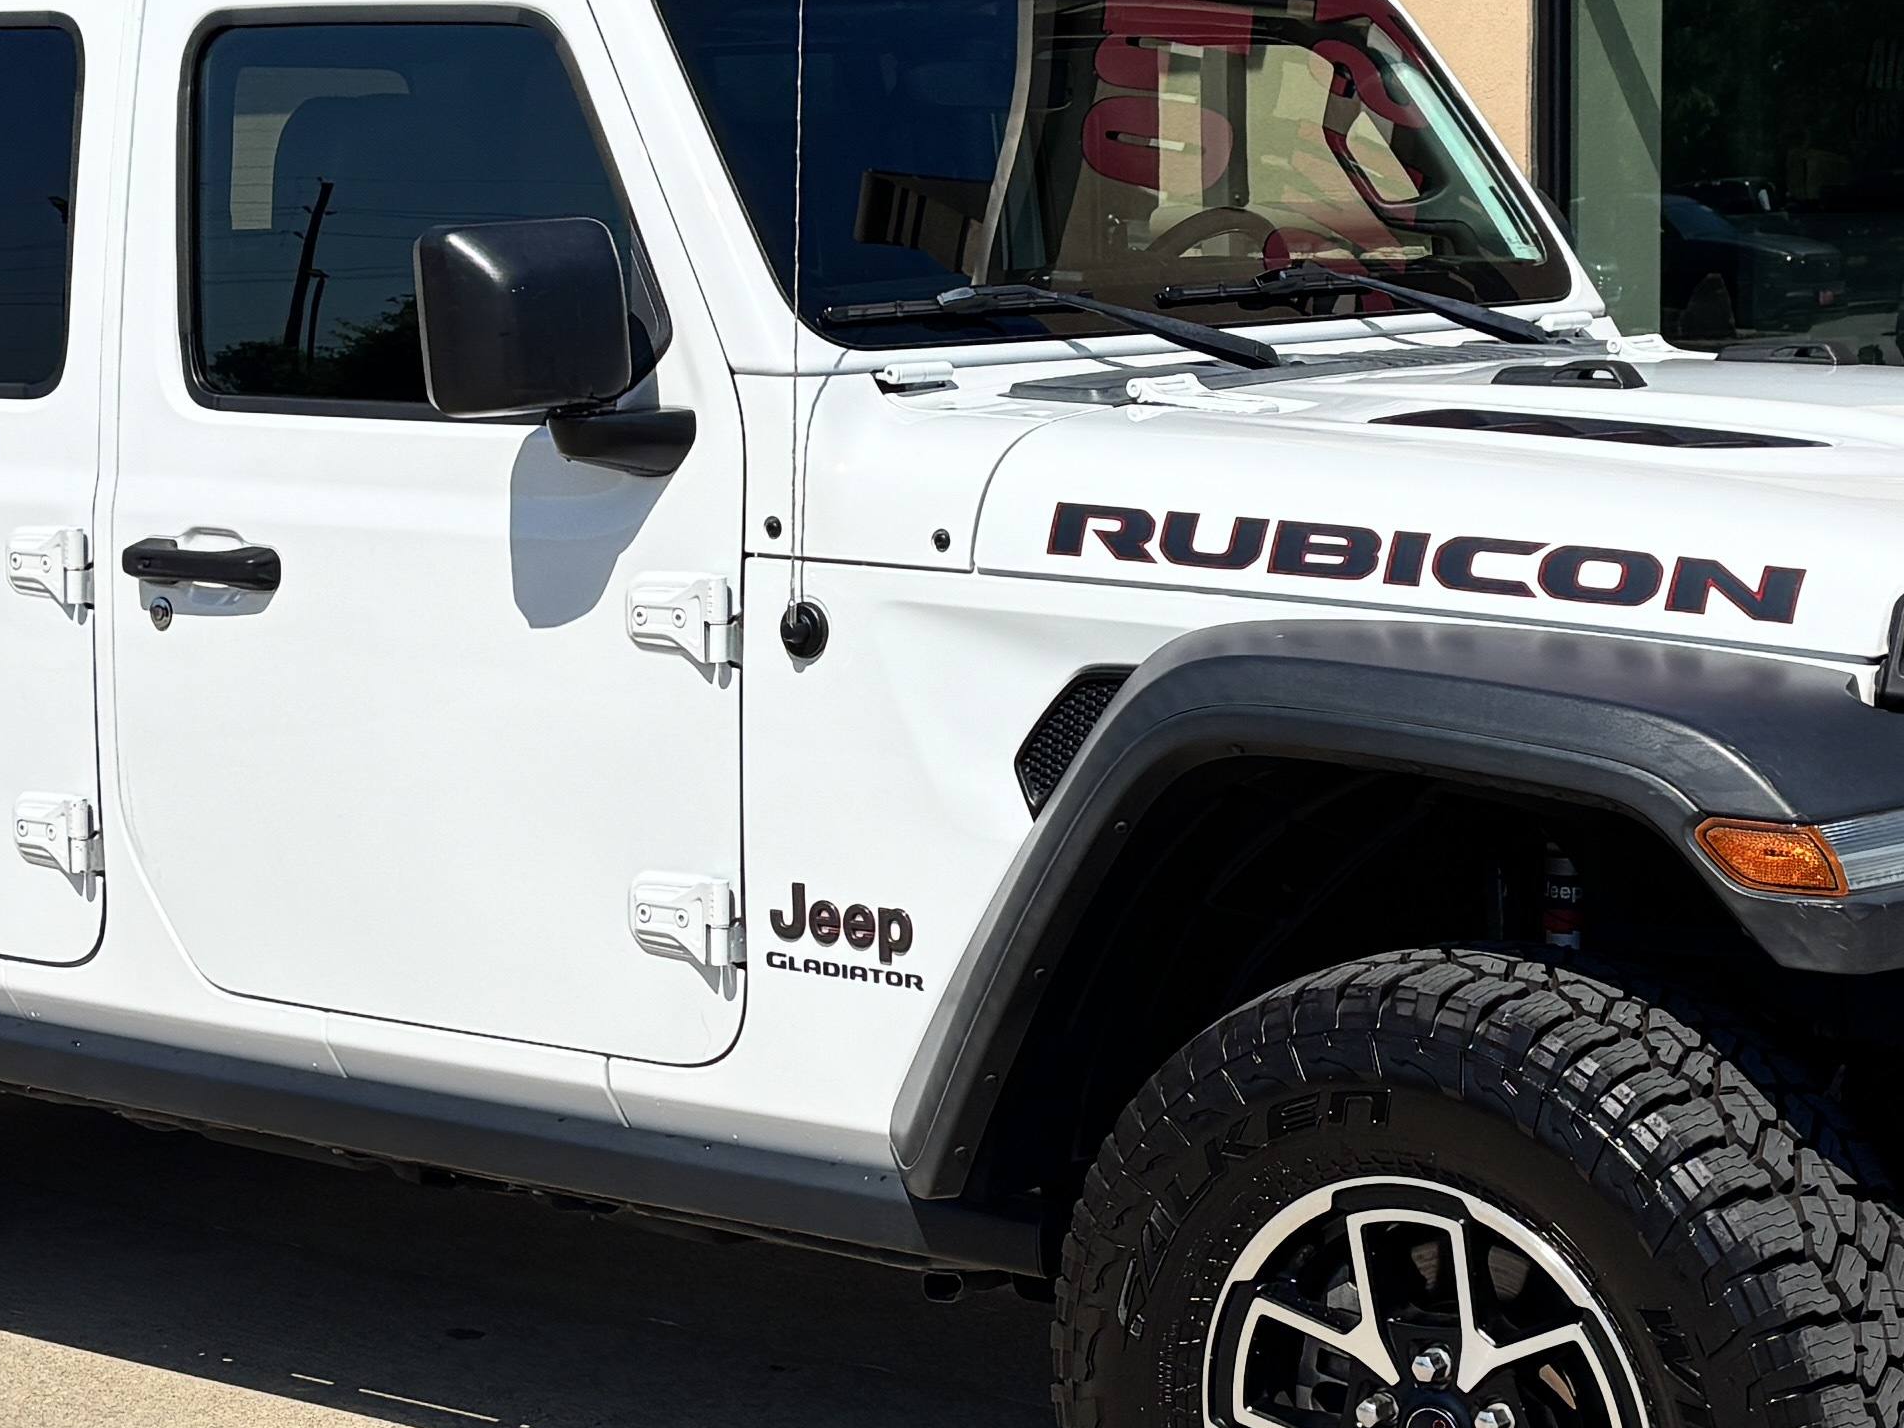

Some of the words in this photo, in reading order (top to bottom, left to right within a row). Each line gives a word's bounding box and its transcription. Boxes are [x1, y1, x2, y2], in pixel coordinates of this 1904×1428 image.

[1046, 501, 1807, 624] RUBICON
[1544, 879, 1584, 904] Jeep
[769, 882, 914, 966] Jeep
[766, 951, 925, 992] GLADIATOR
